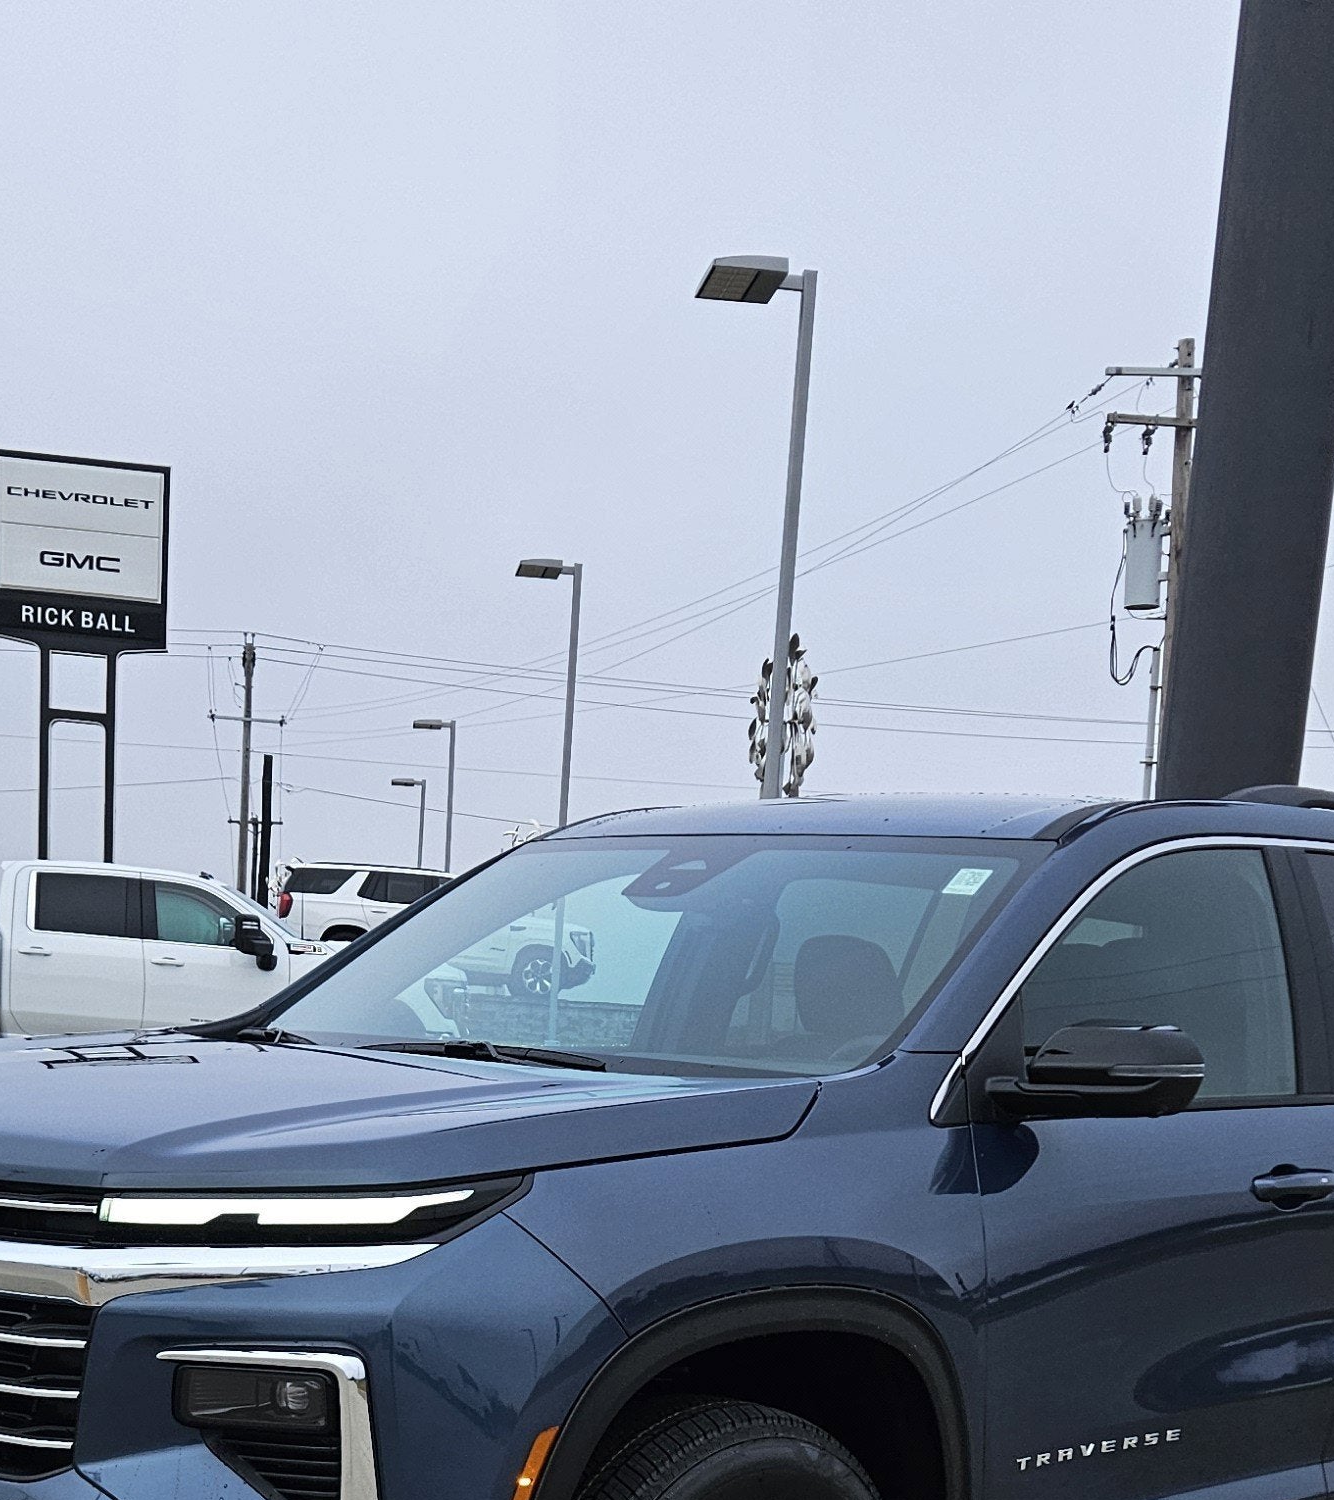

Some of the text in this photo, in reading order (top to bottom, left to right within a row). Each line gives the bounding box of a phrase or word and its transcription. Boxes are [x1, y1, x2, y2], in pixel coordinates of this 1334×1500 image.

[6, 485, 155, 510] CHEVROLET
[39, 550, 121, 573] GMC
[21, 604, 136, 634] RICK BALL
[1016, 1428, 1182, 1472] TRAVERSE
